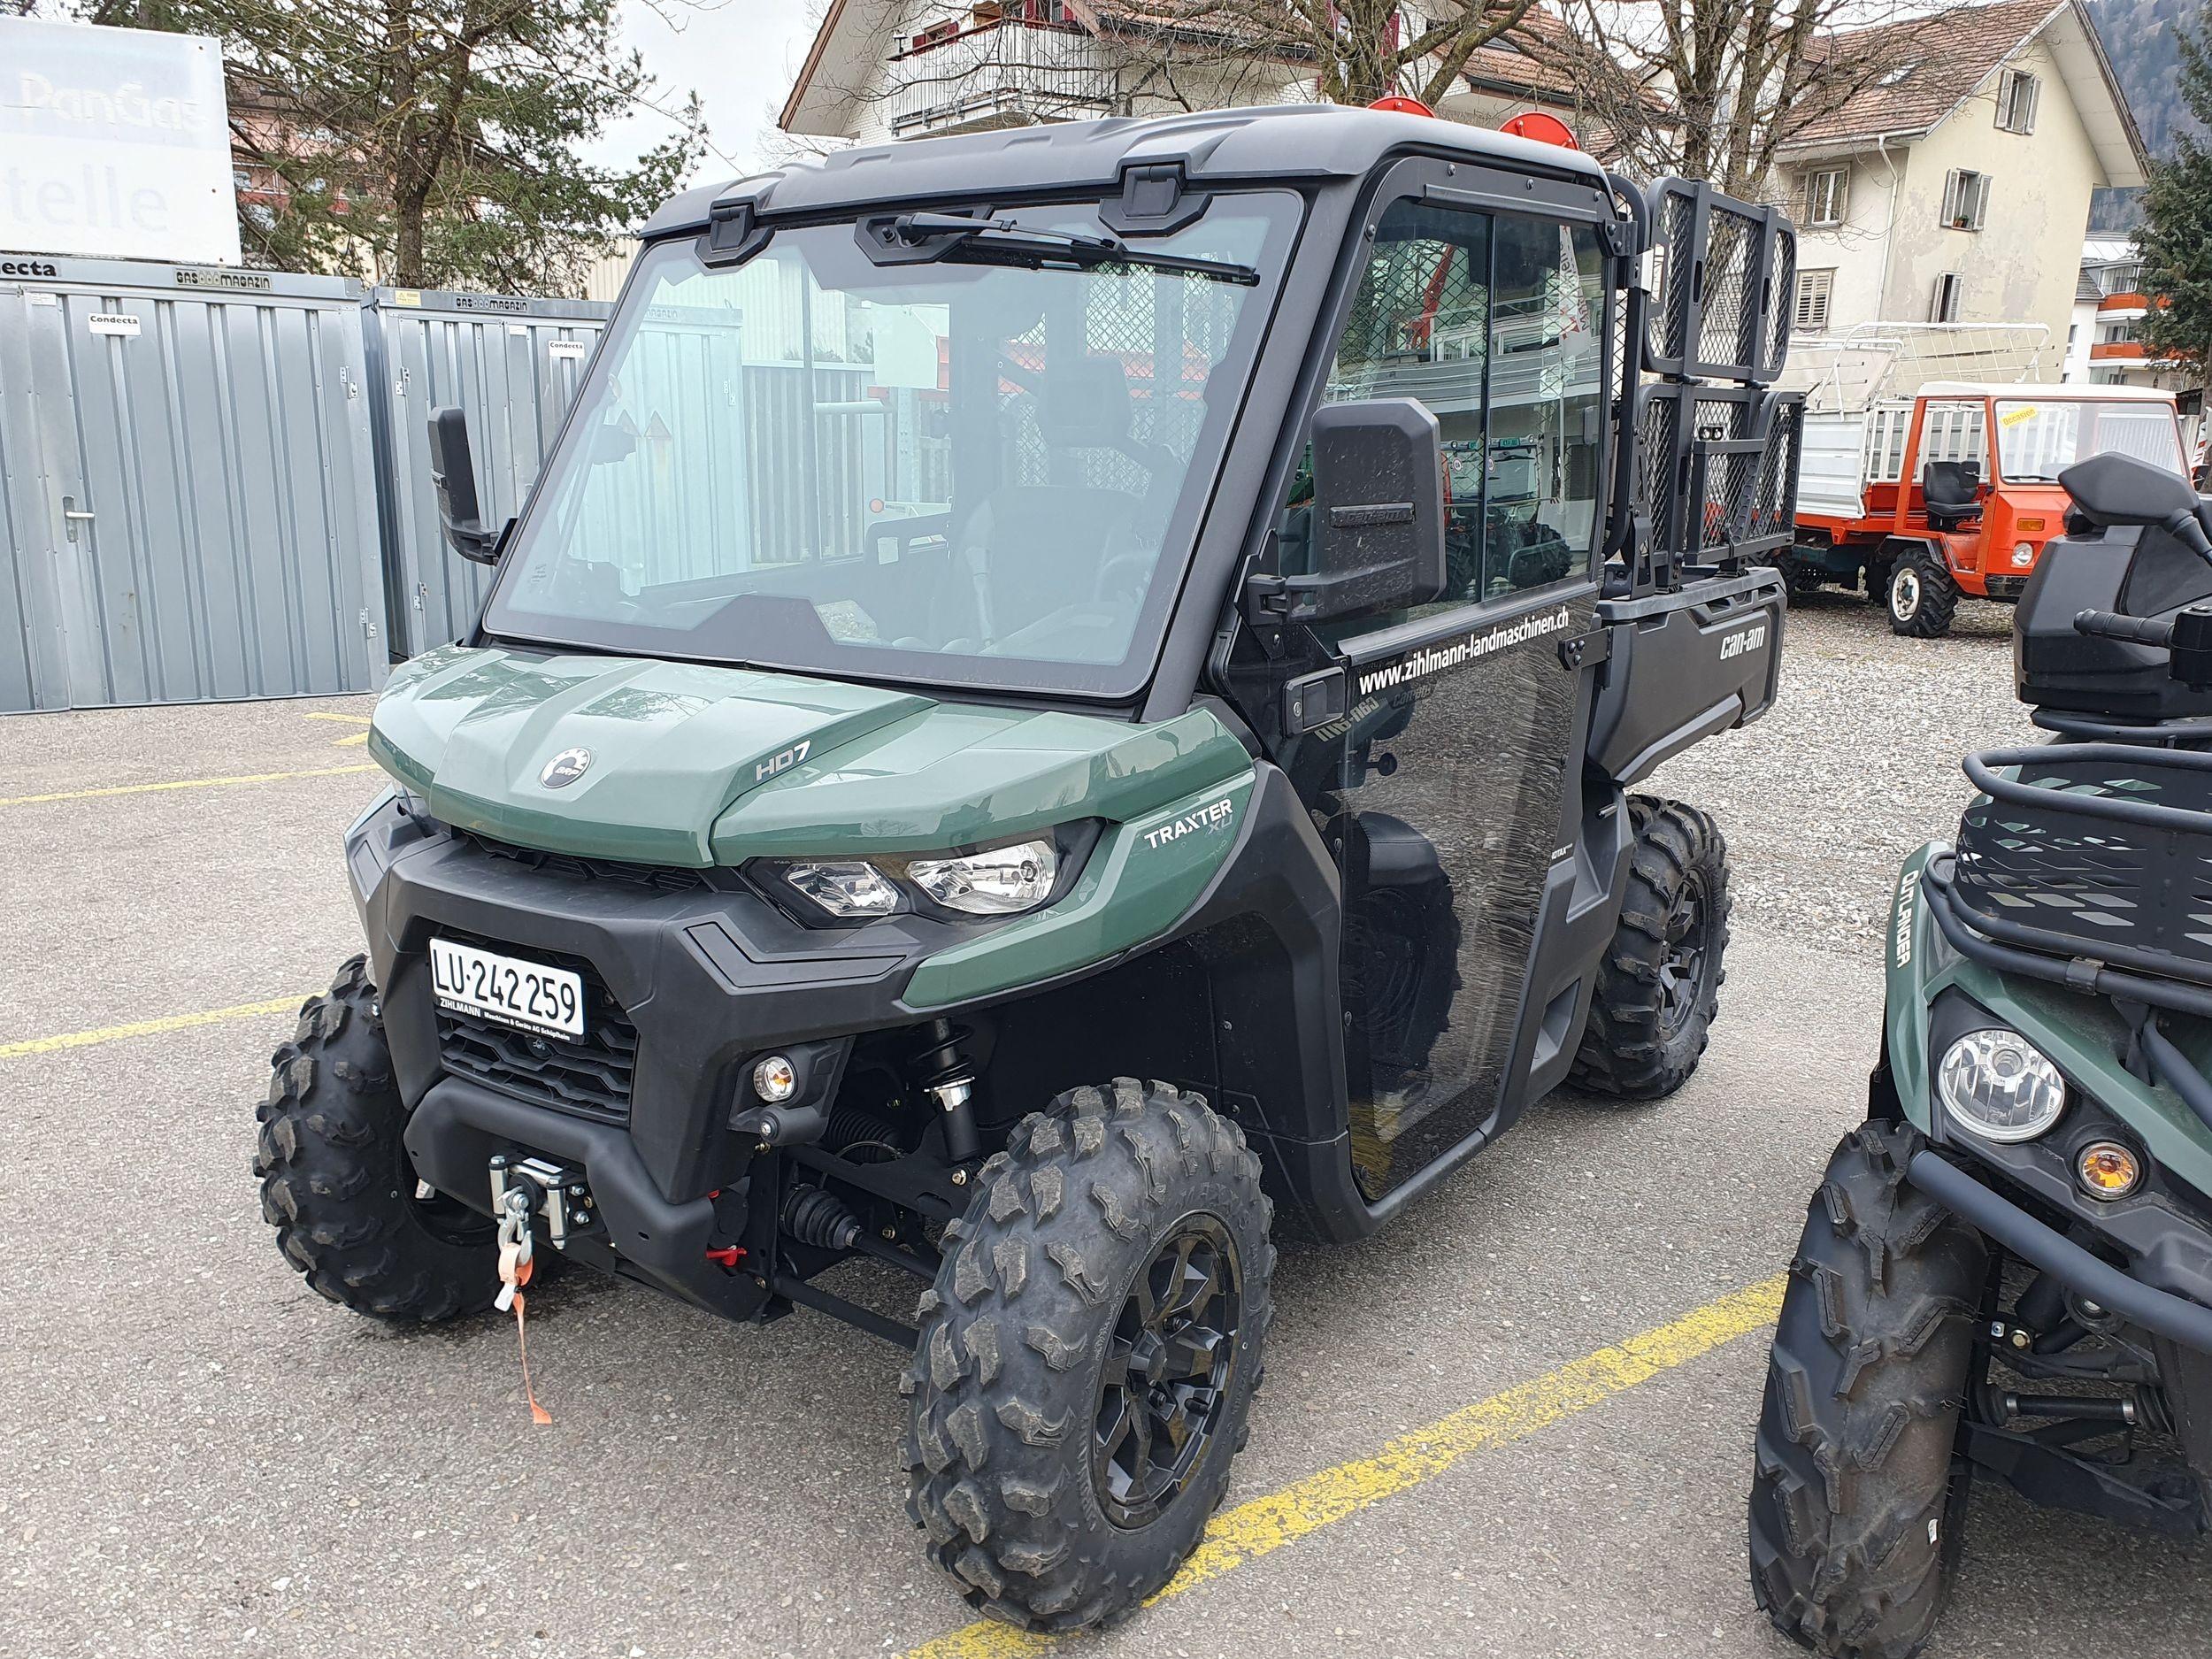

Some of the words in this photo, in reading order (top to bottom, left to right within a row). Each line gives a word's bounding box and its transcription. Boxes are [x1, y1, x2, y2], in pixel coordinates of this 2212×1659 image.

[0, 260, 58, 277] ecta
[176, 271, 198, 285] GAS
[220, 273, 271, 289] MAGAZIN
[456, 297, 472, 308] GAS
[489, 299, 527, 311] MAGAZIN
[90, 315, 138, 326] Condecta
[2002, 409, 2036, 426] Occasion
[1358, 606, 1569, 695] www.zihlmann-landmaschinen.ch
[1719, 625, 1766, 660] can-am
[554, 765, 580, 776] BRP
[756, 740, 812, 782] HD7
[1143, 798, 1233, 849] TRAXTER
[1896, 870, 1919, 969] OUTLANDER
[440, 997, 481, 1018] ZIHLMANN
